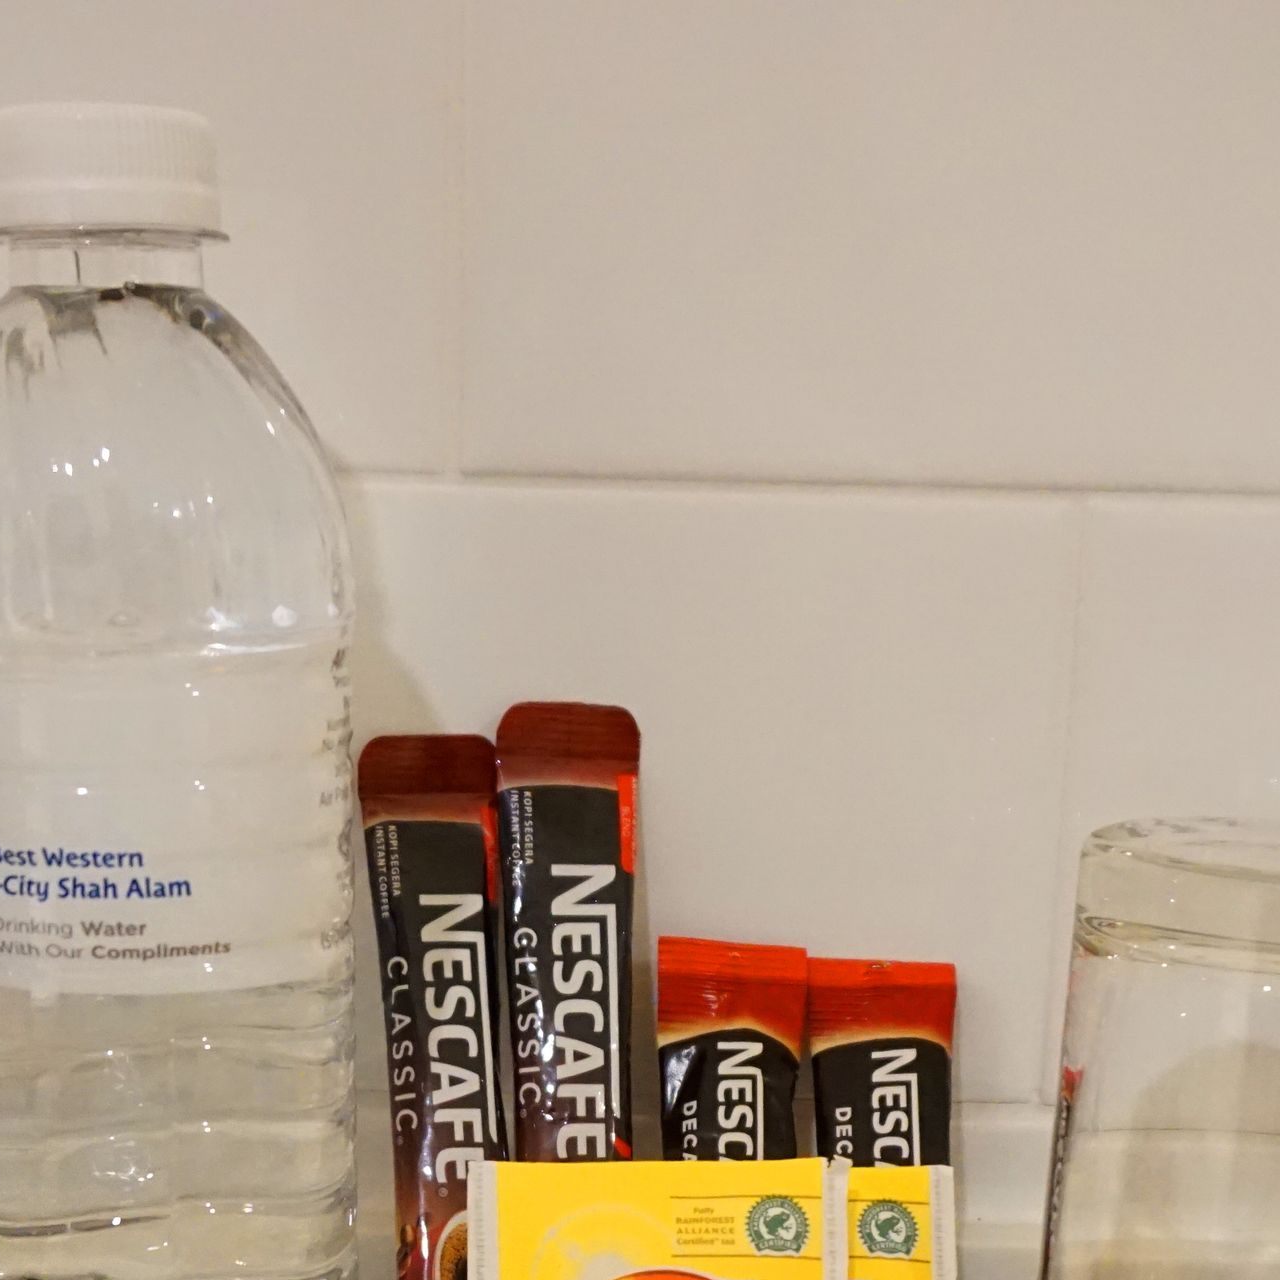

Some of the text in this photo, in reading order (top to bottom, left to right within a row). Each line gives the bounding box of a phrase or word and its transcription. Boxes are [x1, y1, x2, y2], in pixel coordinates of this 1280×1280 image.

[509, 790, 520, 838] INSTANT
[523, 791, 534, 865] KOPI SEGERA
[41, 848, 144, 868] Western
[57, 877, 119, 899] Shah
[126, 878, 192, 899] Alam
[375, 826, 390, 918] INSTANT COFFEE
[388, 825, 401, 896] KOPI SEGERA
[46, 944, 84, 959] Our
[91, 940, 232, 961] Compliments
[80, 921, 147, 936] Water
[386, 956, 418, 1133] CLASSIC
[513, 927, 543, 1106] CLASSIC
[717, 1041, 763, 1161] NESC
[871, 1048, 919, 1167] NESC
